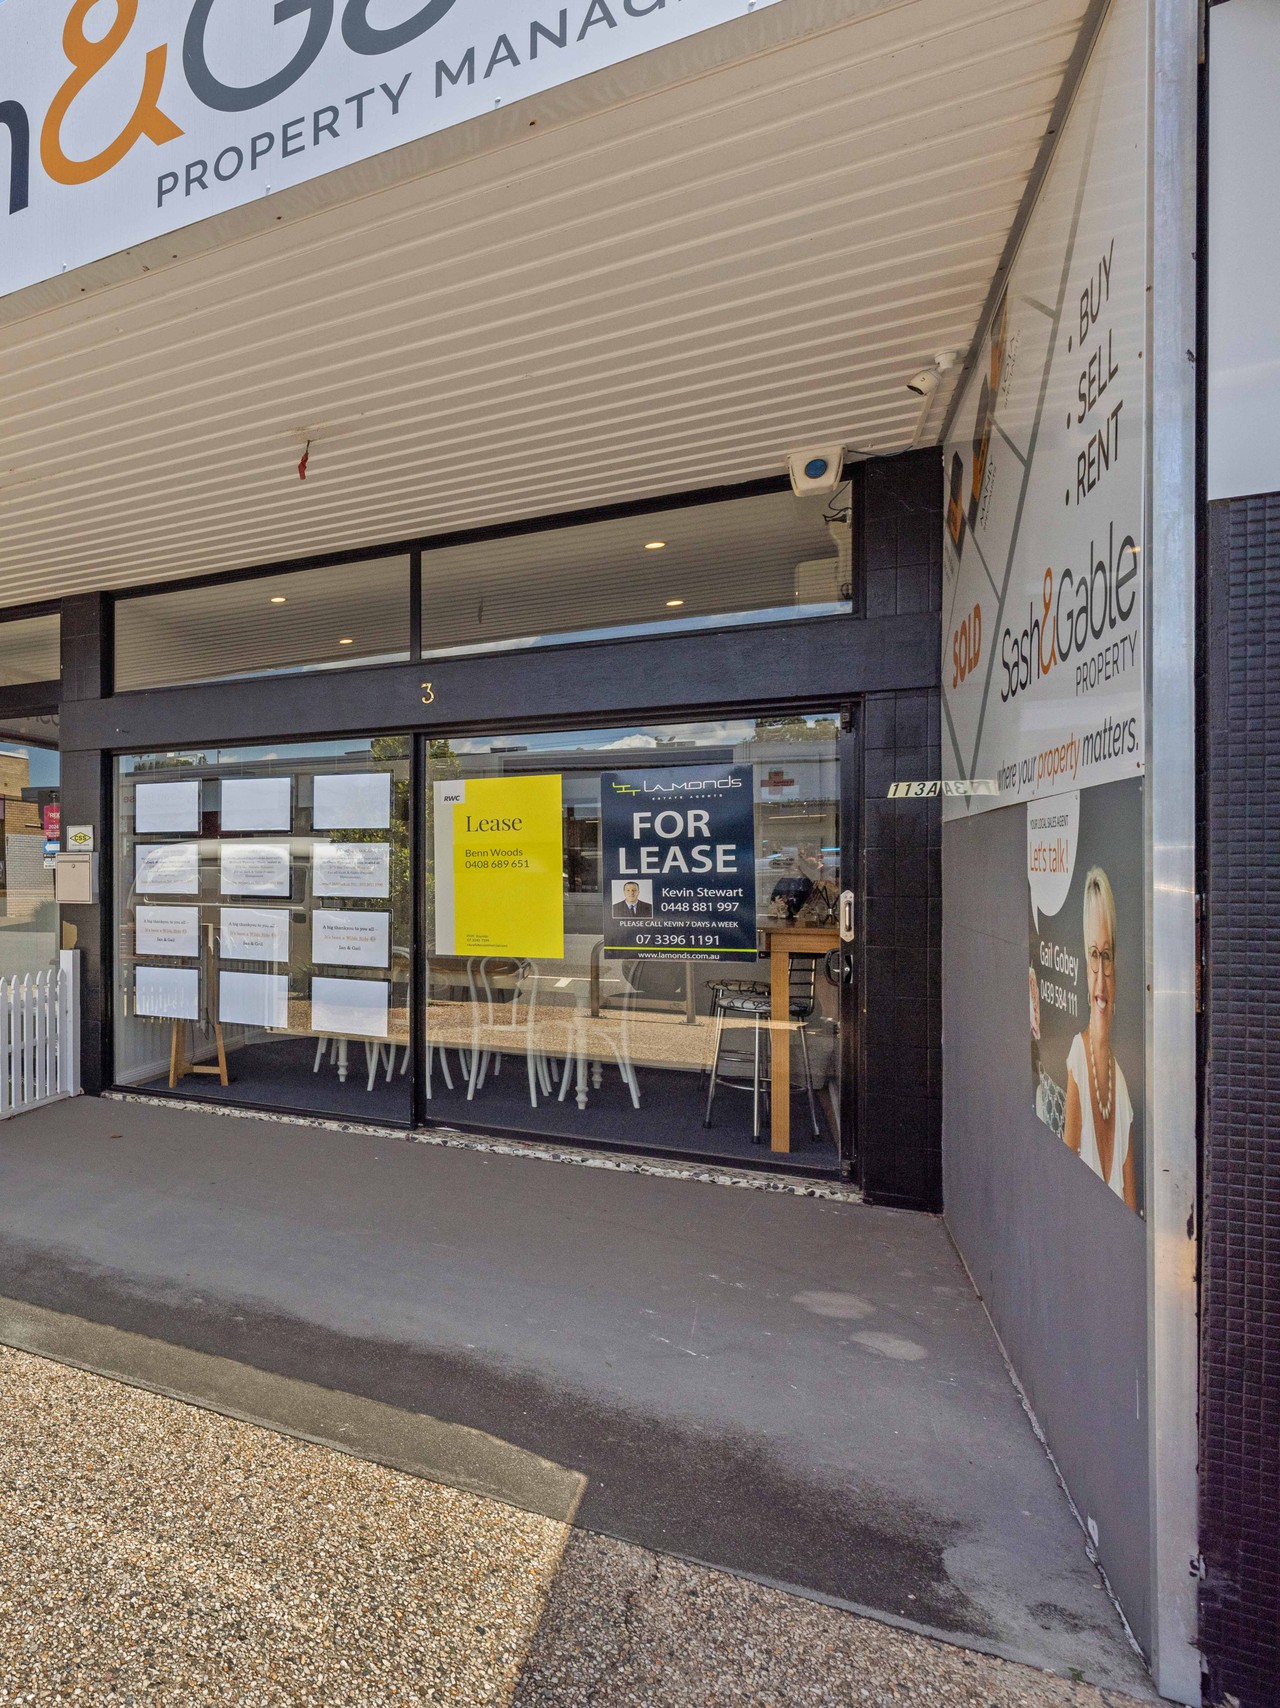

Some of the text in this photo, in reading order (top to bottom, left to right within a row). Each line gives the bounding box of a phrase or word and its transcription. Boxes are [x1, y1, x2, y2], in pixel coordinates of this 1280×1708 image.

[157, 73, 412, 207] PROPERTY
[1079, 238, 1114, 346] BUY
[1077, 329, 1119, 424] SELL
[1076, 400, 1123, 505] RENT
[1001, 521, 1138, 702] Sash&Gable
[952, 603, 982, 689] SOLD
[1075, 630, 1137, 697] PROPERTY
[421, 682, 435, 704] 3
[997, 716, 1139, 794] where your property matters.
[891, 782, 938, 797] 113A
[465, 814, 523, 833] Lease
[633, 809, 711, 839] FOR
[1037, 818, 1047, 829] LOCAL
[1047, 816, 1056, 829] SALES
[1056, 815, 1069, 828] AGENT
[465, 848, 523, 857] Benn Woods
[465, 859, 529, 869] 0408 689 651
[619, 844, 738, 875] LEASE
[1030, 840, 1047, 872] Let's
[661, 886, 743, 898] Kevin Stewart
[661, 901, 739, 912] 0448 881 997
[619, 920, 644, 928] PLEASE
[645, 920, 662, 928] CALL
[636, 934, 720, 946] 07 3396 1191
[638, 951, 720, 960] www.lamonds.com.au
[1040, 941, 1079, 986] Gail Gobey
[1041, 979, 1078, 1017] 0439 584 111
